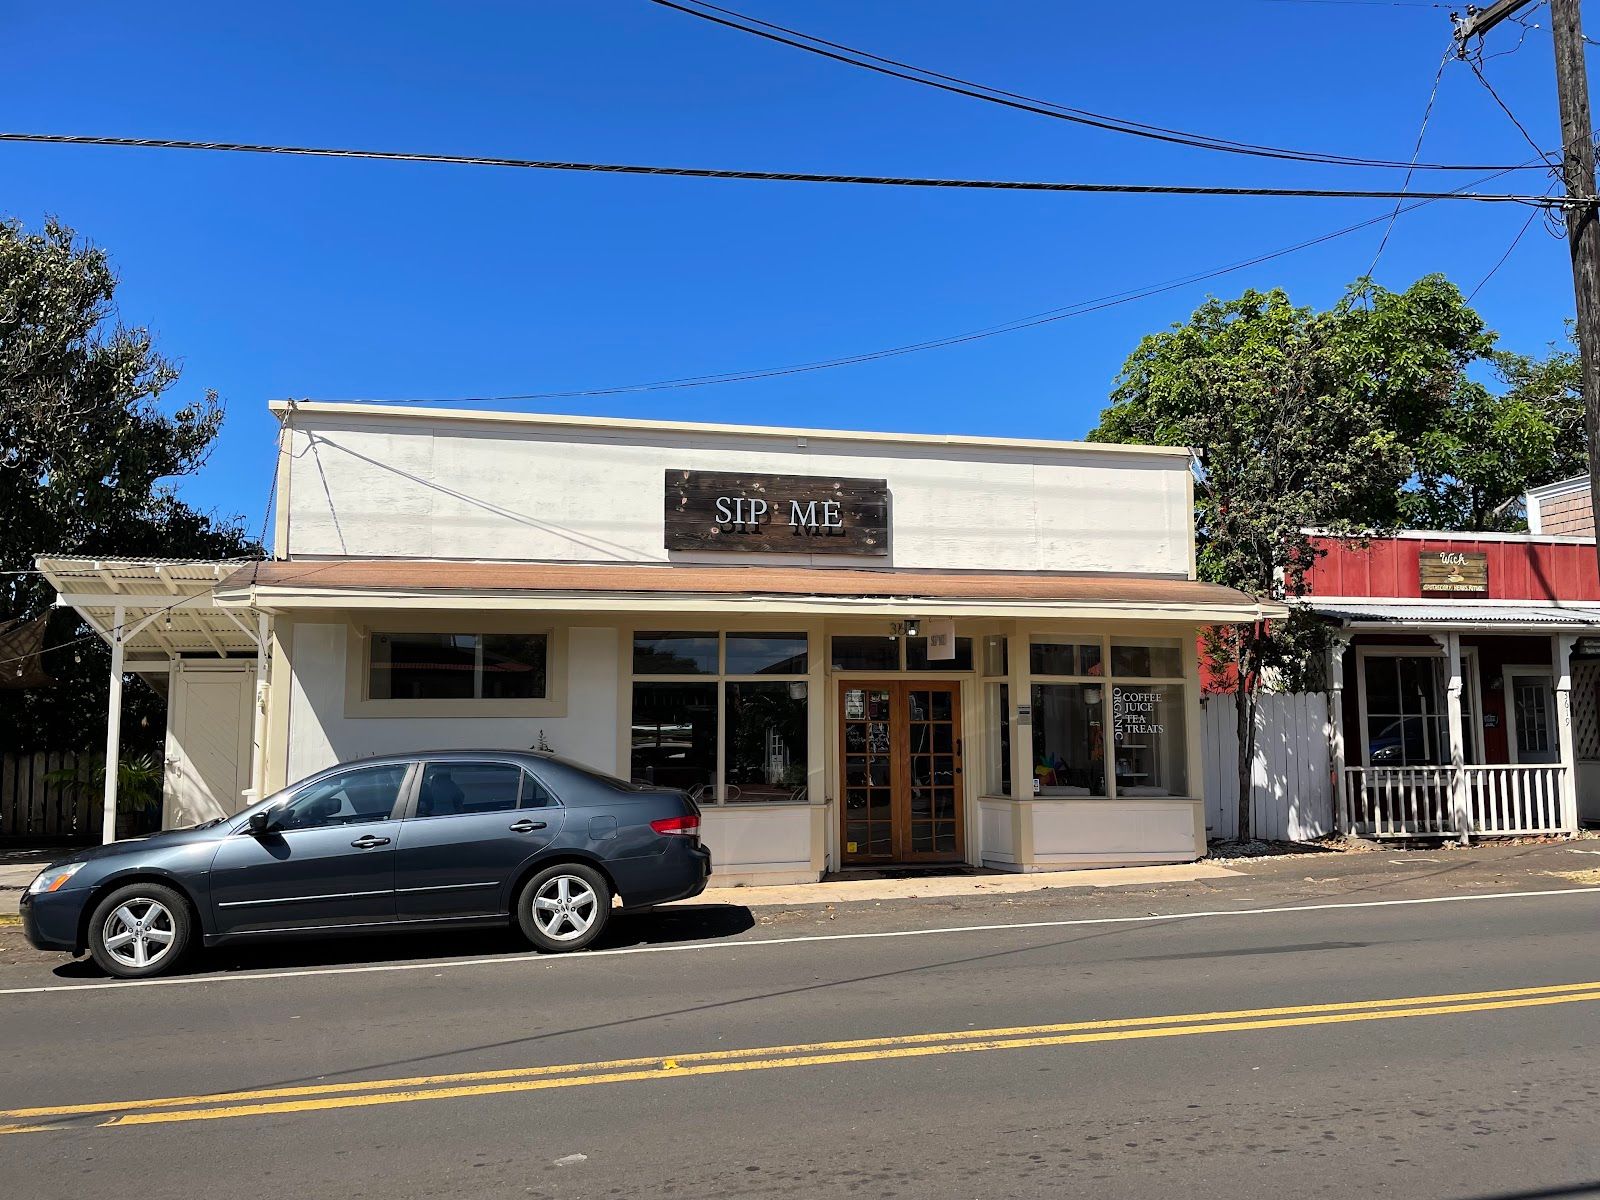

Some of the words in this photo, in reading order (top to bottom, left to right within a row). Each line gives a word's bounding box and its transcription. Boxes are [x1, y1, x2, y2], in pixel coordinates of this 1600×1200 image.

[715, 496, 768, 525] SIP
[788, 499, 843, 527] ME
[1440, 552, 1469, 566] Wick
[1122, 692, 1162, 702] COFFEE
[1113, 687, 1123, 740] ORGANIC
[1124, 702, 1154, 714] JUICE
[1125, 714, 1147, 724] TEA
[1125, 724, 1164, 734] TREATS
